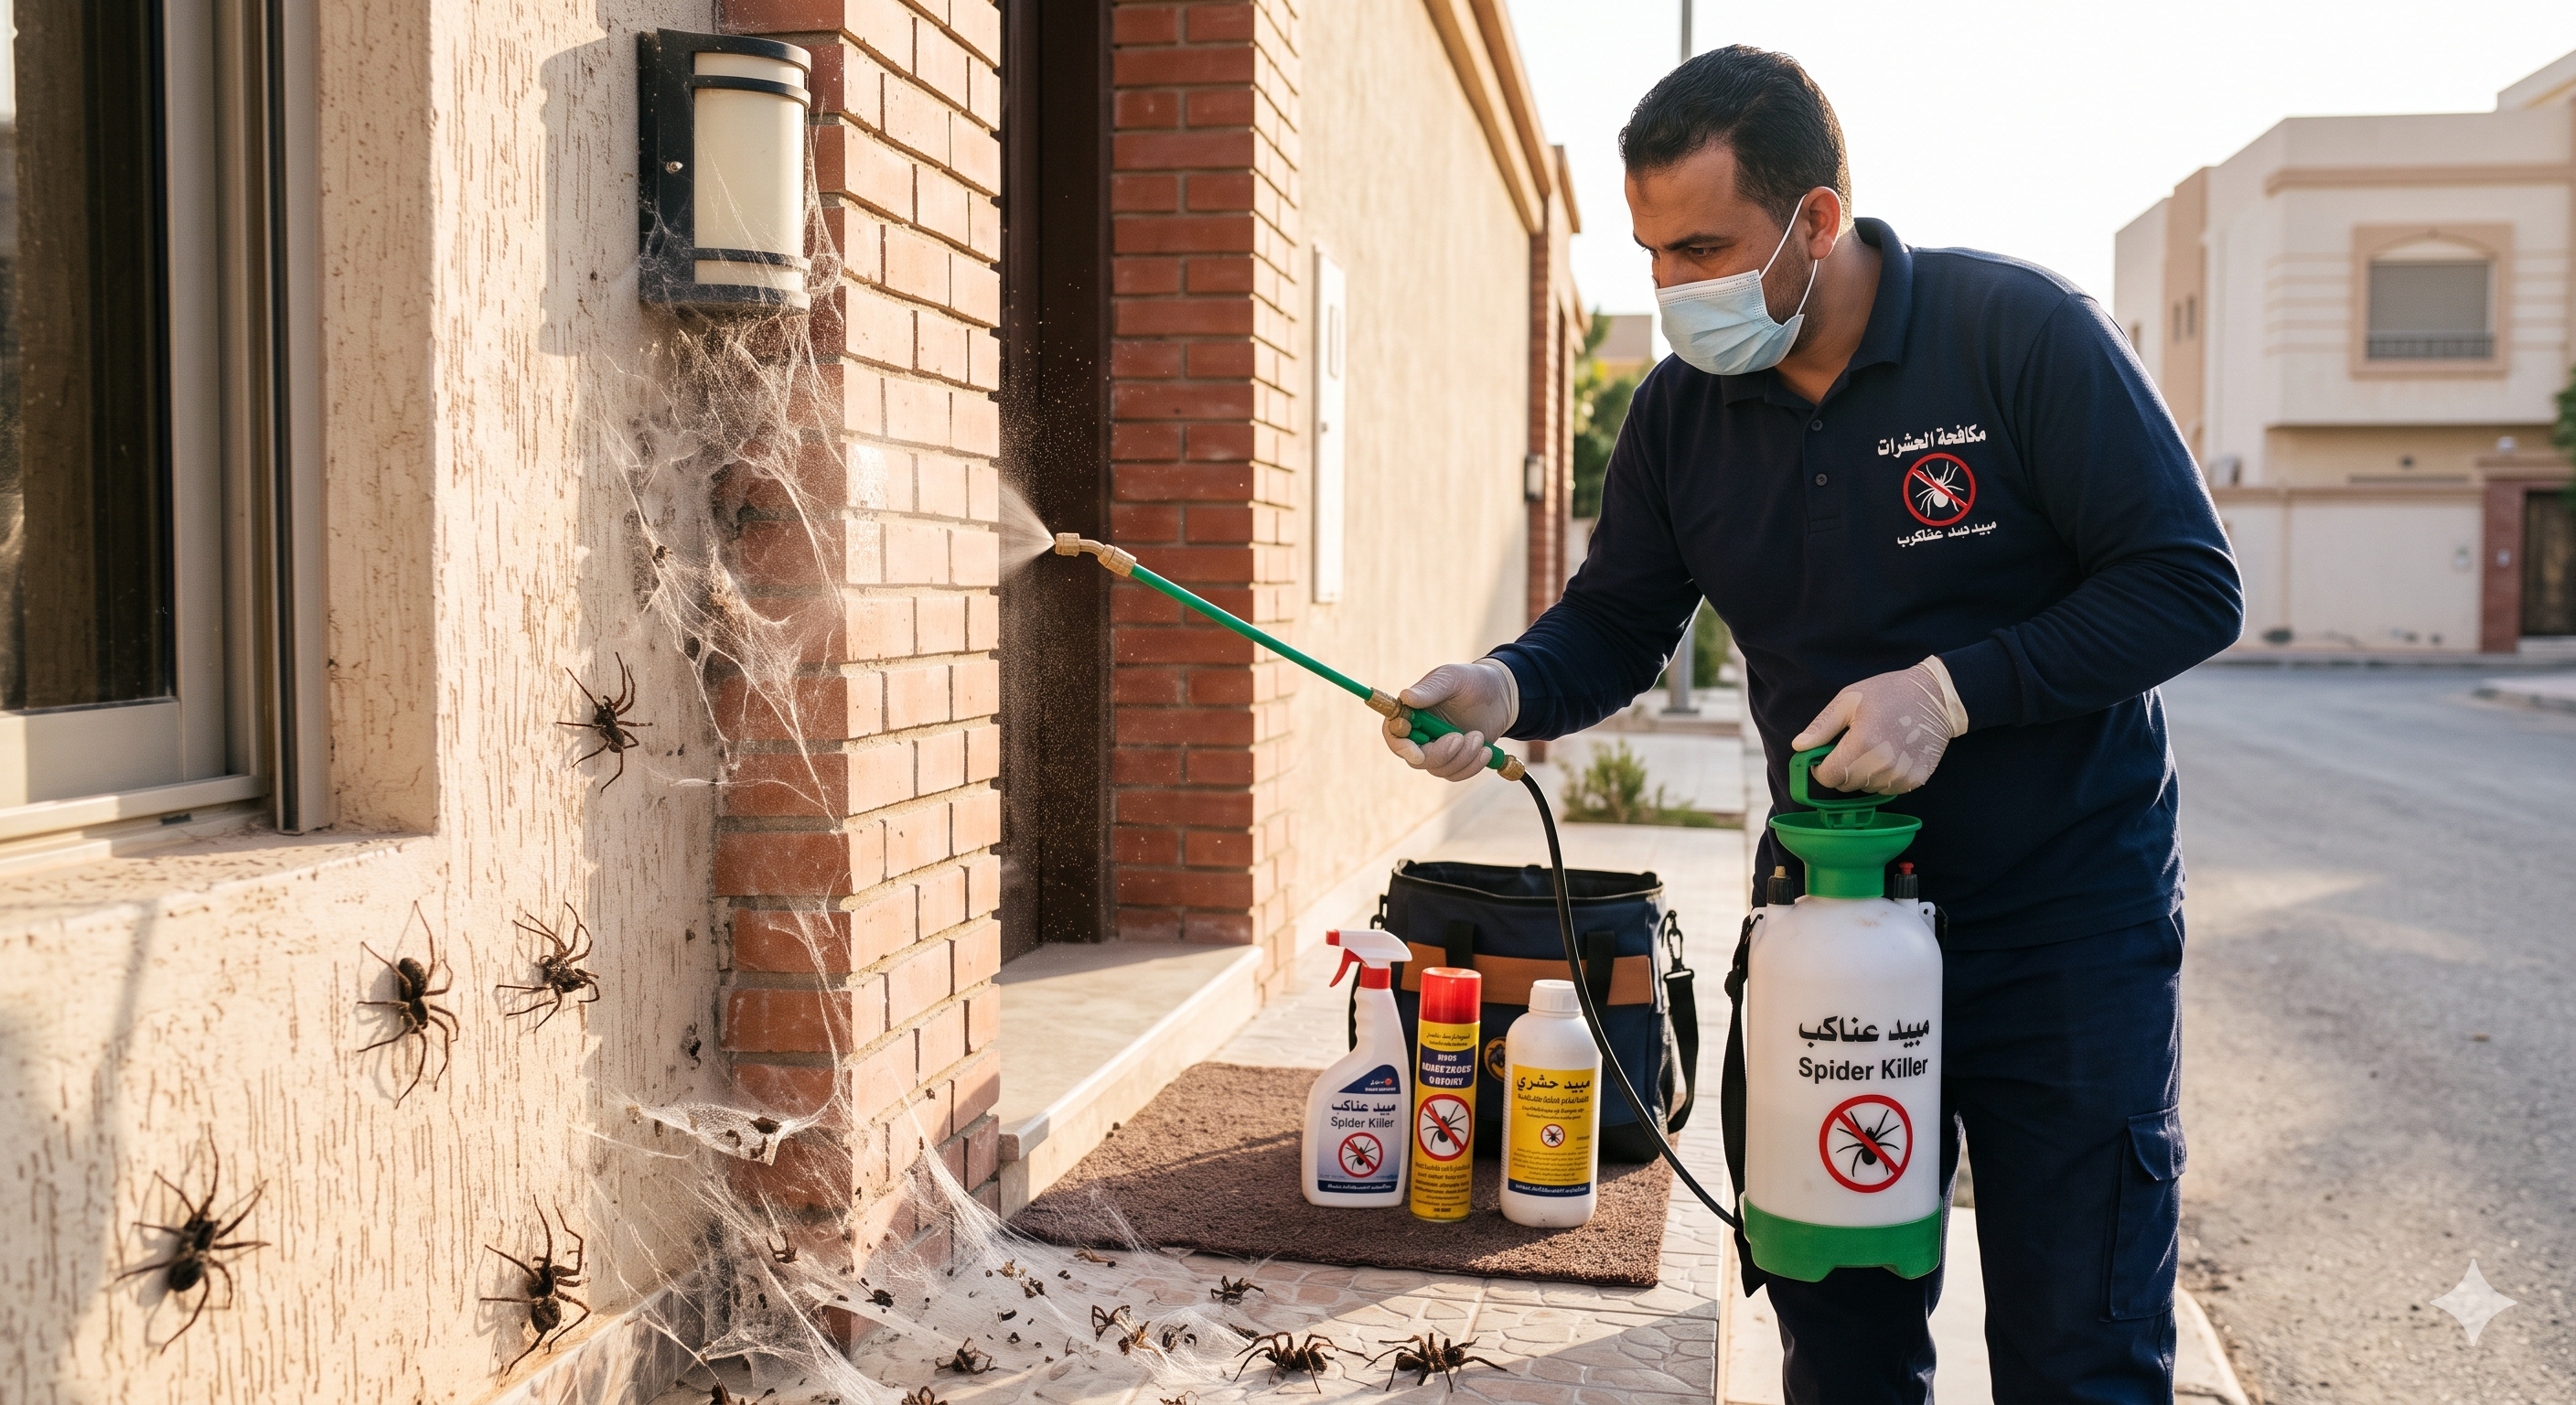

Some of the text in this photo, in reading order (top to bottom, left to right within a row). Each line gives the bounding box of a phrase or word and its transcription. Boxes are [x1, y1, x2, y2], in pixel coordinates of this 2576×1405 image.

[1877, 424, 1987, 458] مكافحة الحشرات
[1798, 1015, 1930, 1048] مبيد عناكب
[1517, 1074, 1591, 1093] مبيد حشري
[1798, 1056, 1928, 1084] Spider Killer
[1331, 1099, 1368, 1115] عناكب
